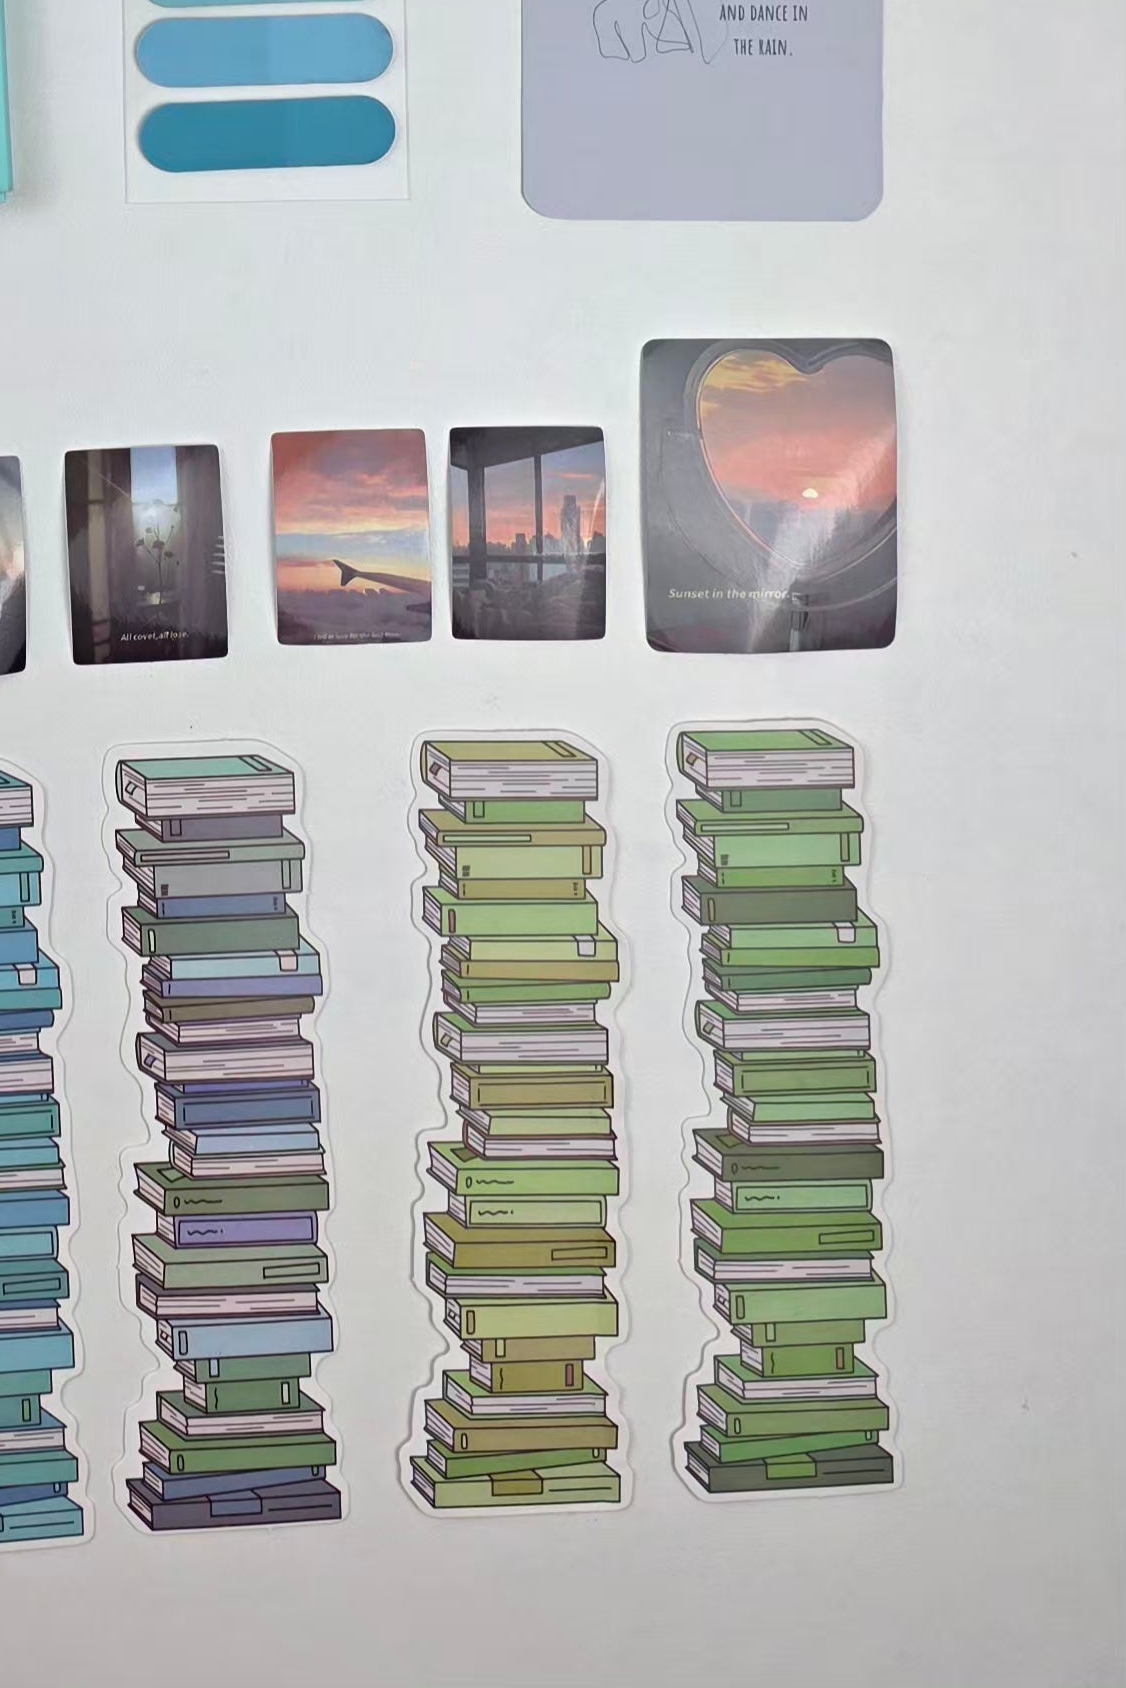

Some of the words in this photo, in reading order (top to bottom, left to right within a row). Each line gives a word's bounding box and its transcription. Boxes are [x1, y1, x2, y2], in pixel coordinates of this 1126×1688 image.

[719, 4, 744, 21] AND
[750, 5, 787, 21] DANCE
[793, 5, 808, 21] IN
[734, 38, 753, 56] THE
[758, 39, 793, 56] RAIN.
[668, 589, 710, 599] Sunset
[713, 589, 723, 599] in
[727, 589, 746, 599] the
[748, 589, 790, 600] mirror.
